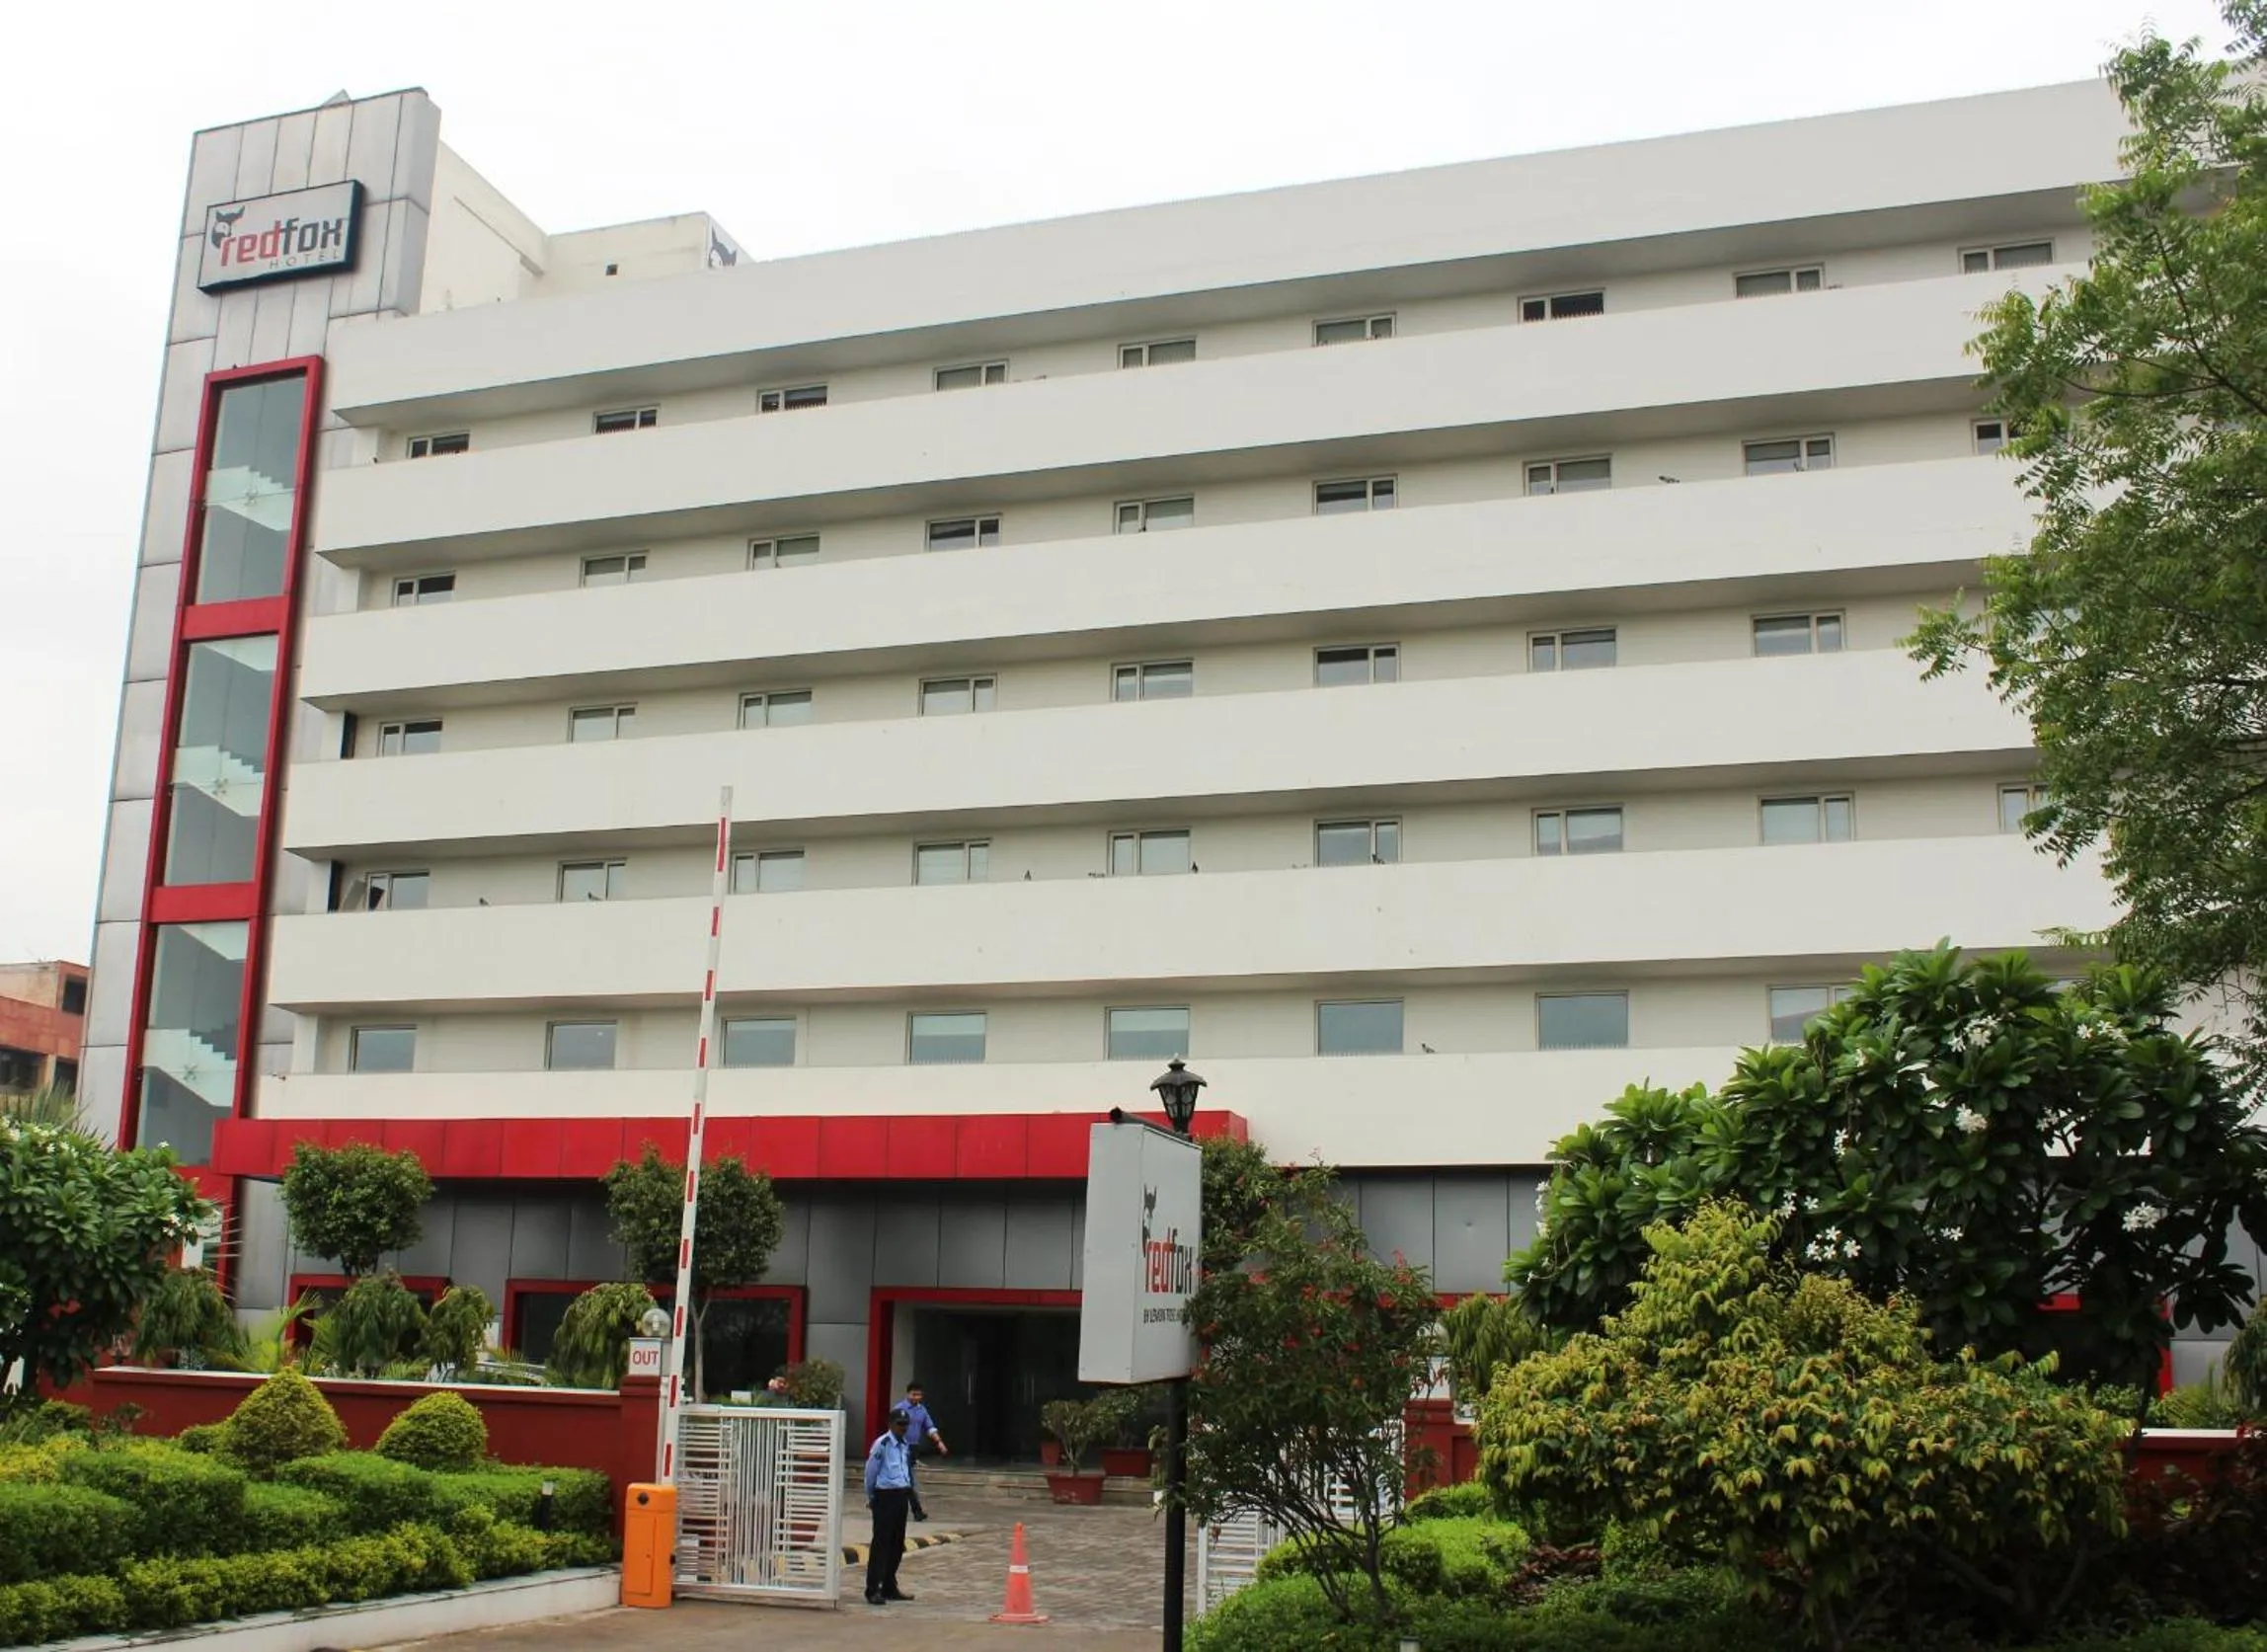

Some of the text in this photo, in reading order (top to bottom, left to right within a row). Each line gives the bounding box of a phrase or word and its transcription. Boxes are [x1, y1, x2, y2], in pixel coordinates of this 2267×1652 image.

[220, 217, 343, 267] redfox
[269, 251, 341, 270] HOTEL
[1145, 1225, 1193, 1294] redfox
[633, 1350, 659, 1365] OUT
